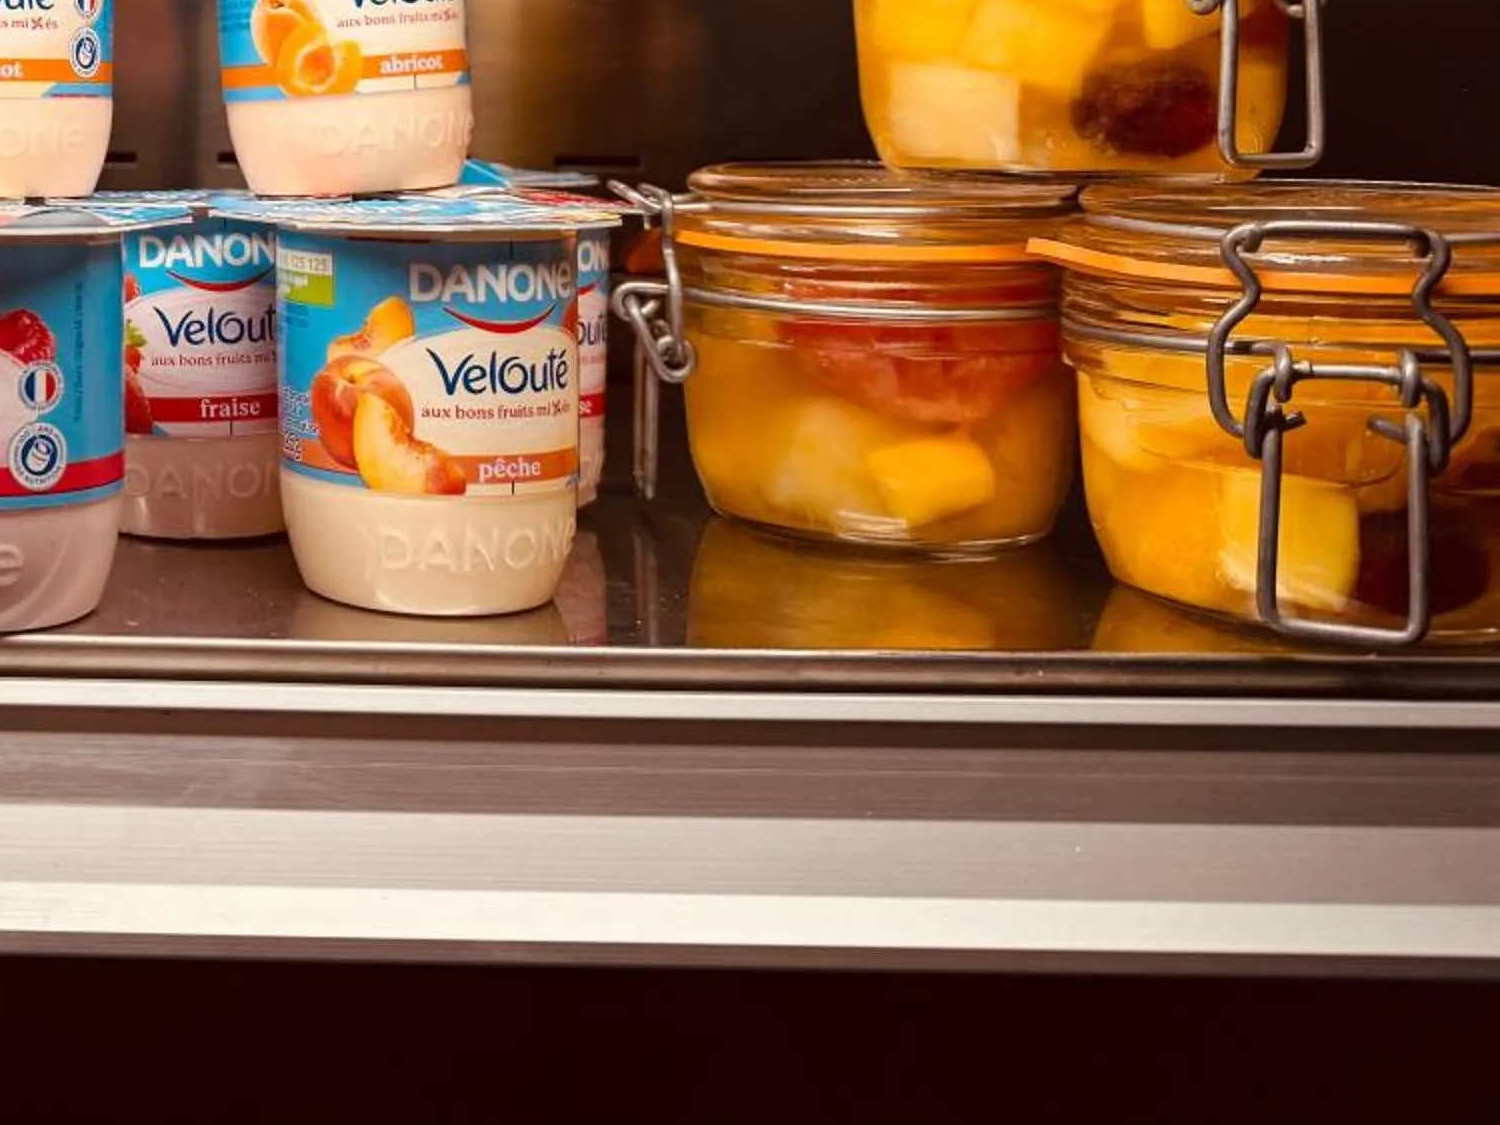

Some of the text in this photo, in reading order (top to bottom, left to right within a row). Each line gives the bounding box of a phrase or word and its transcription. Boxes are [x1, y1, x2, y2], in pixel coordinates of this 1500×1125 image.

[337, 18, 361, 28] aux
[364, 14, 396, 26] bons
[380, 56, 444, 74] abricot
[139, 232, 275, 268] DANON
[153, 305, 276, 348] Velout
[151, 355, 176, 366] aux
[179, 354, 212, 366] bons
[216, 352, 252, 366] fruits
[426, 347, 569, 396] Velouté
[199, 397, 261, 418] fraise
[422, 406, 451, 419] aux
[456, 404, 494, 420] bons
[498, 404, 533, 419] fruits
[479, 457, 542, 482] pêche
